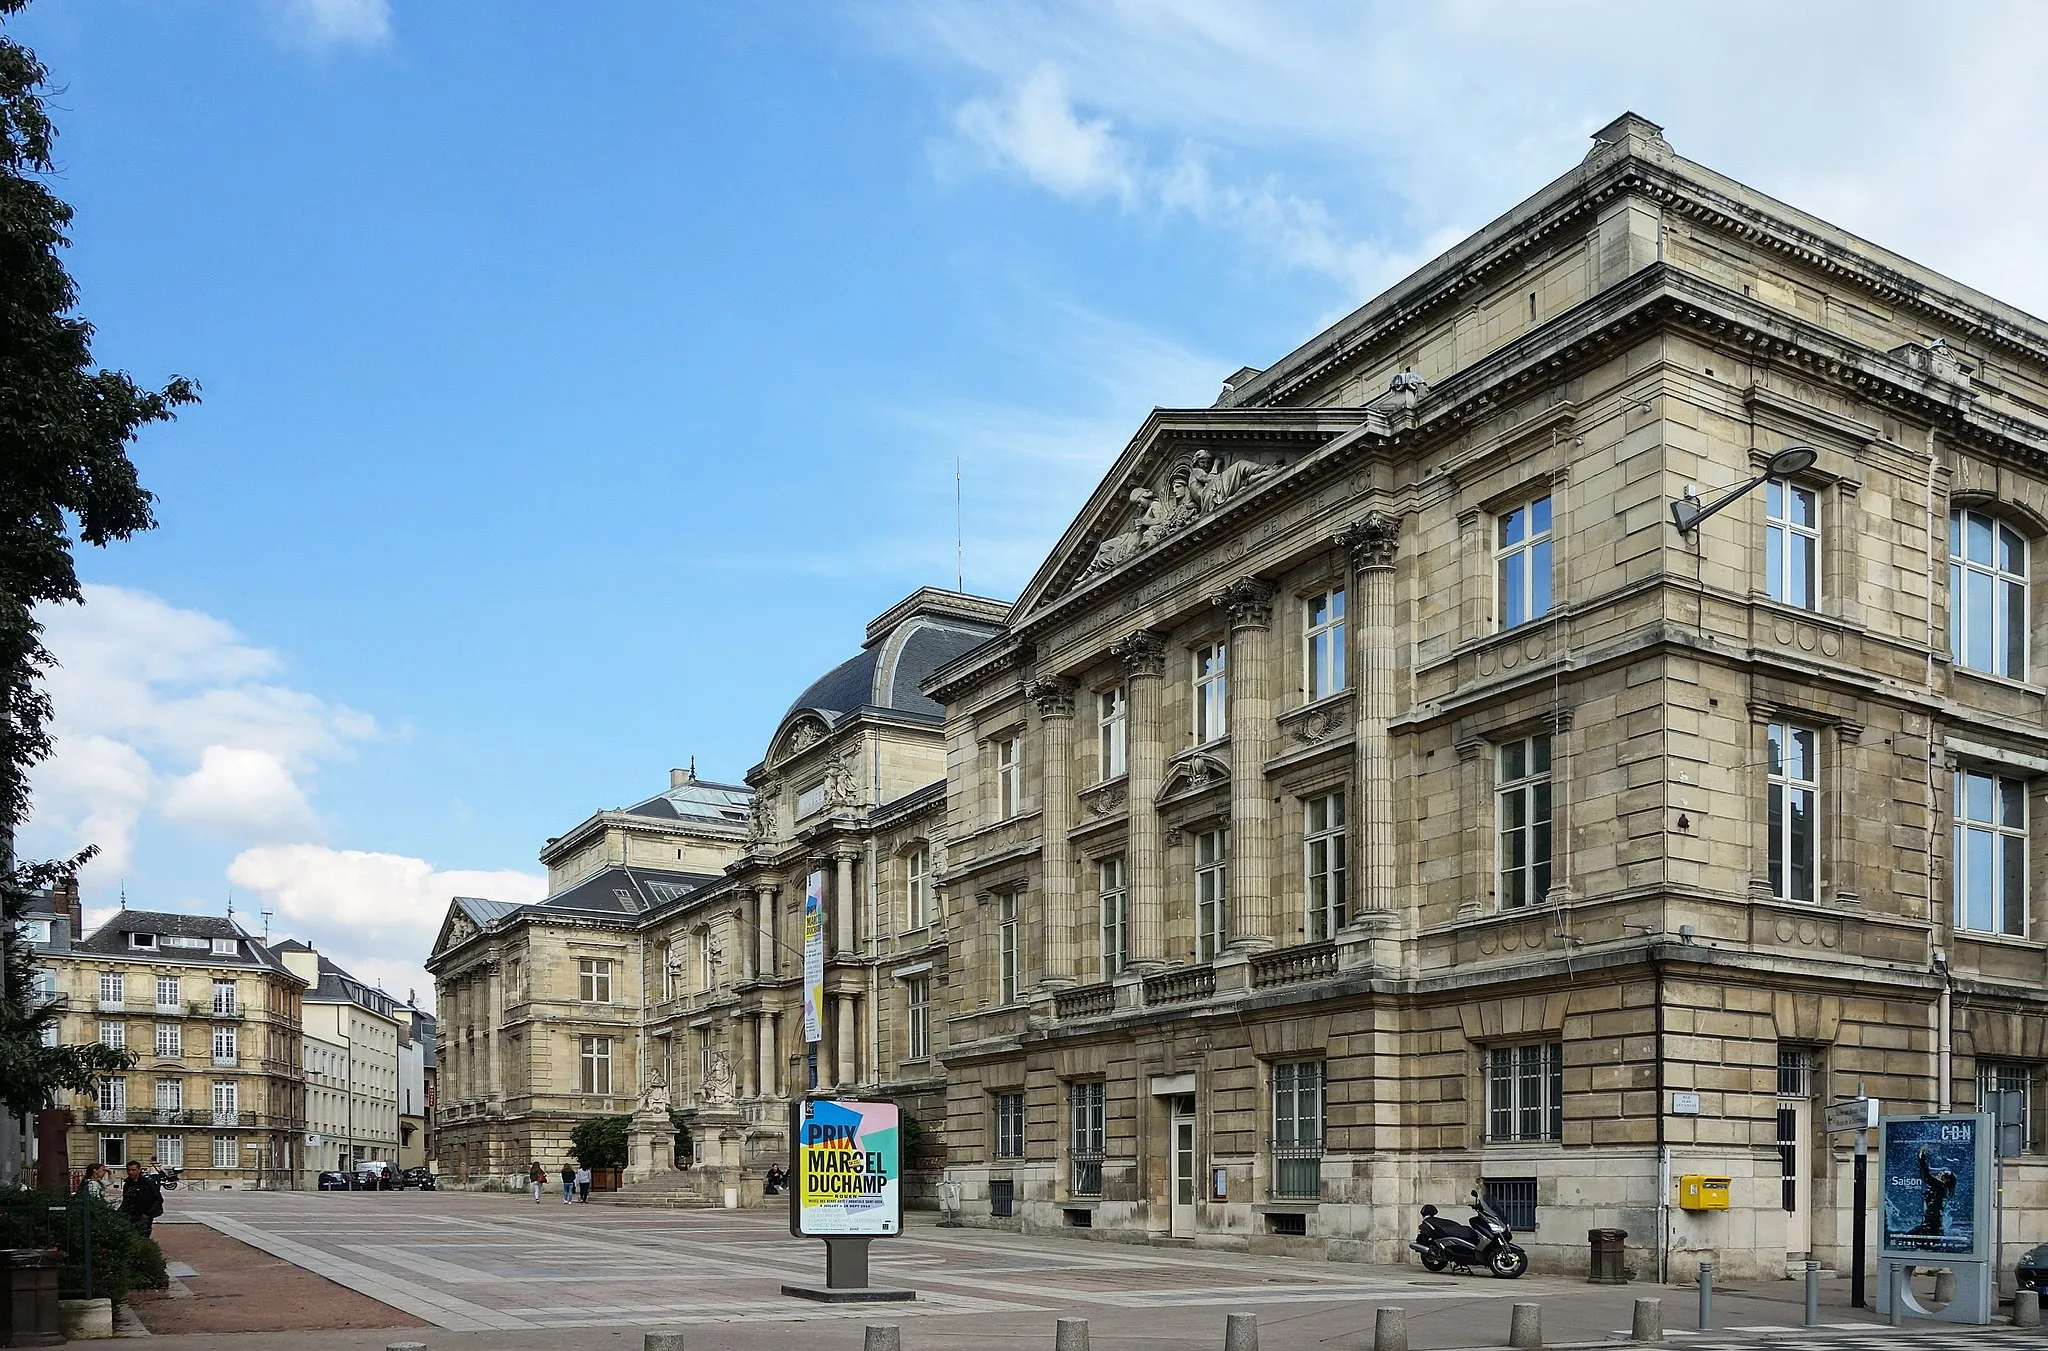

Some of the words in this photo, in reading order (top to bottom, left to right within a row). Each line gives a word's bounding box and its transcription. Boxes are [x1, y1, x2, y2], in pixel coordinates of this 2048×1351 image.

[1146, 553, 1216, 600] ARCHITECTURE
[1060, 609, 1110, 645] SCULPTURE
[808, 1124, 857, 1150] PRIX
[808, 1150, 887, 1174] MARCEL
[808, 1174, 888, 1194] DUCHAMP
[1891, 1176, 1922, 1186] Saison
